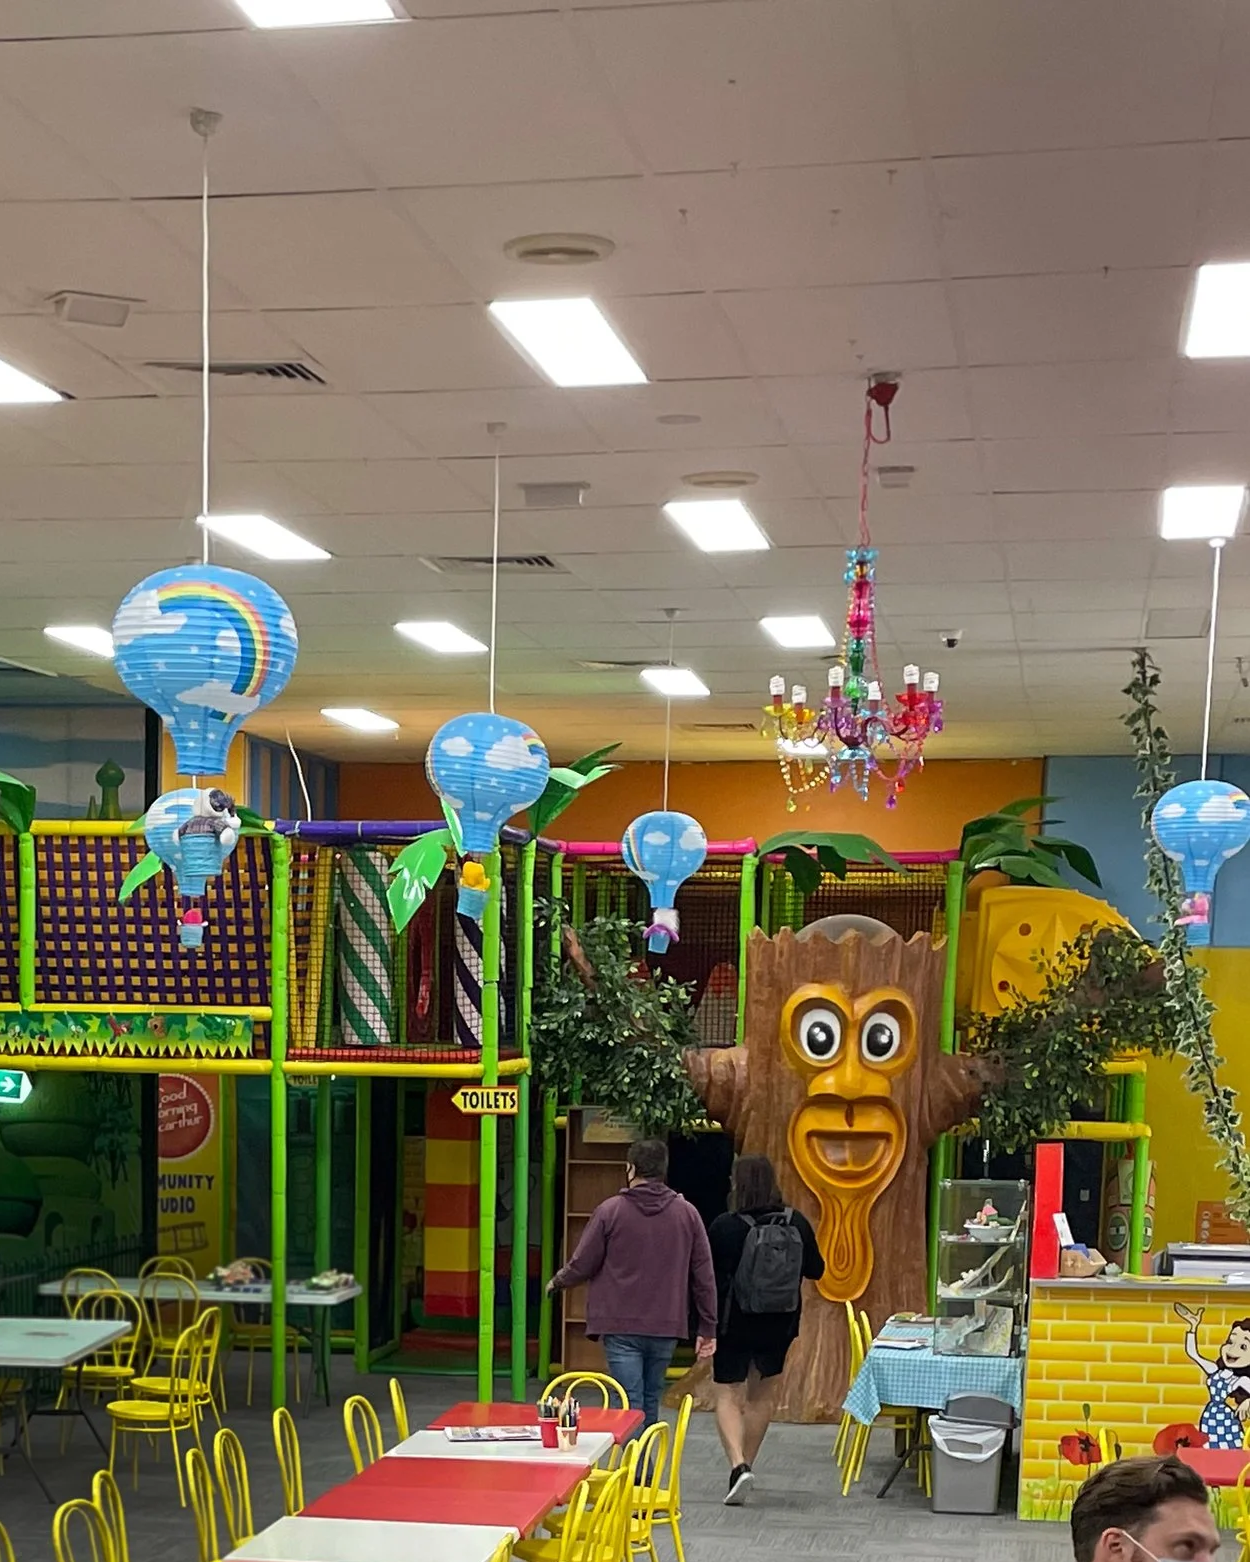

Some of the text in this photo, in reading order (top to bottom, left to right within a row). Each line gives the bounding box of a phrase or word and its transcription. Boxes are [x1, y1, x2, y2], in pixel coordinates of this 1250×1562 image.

[293, 1075, 318, 1085] TOILE
[158, 1082, 187, 1103] ood
[460, 1091, 517, 1109] TOILETS
[158, 1103, 198, 1118] orning
[158, 1112, 203, 1132] carthur
[158, 1174, 214, 1190] MUNITY
[159, 1196, 195, 1213] UDIO
